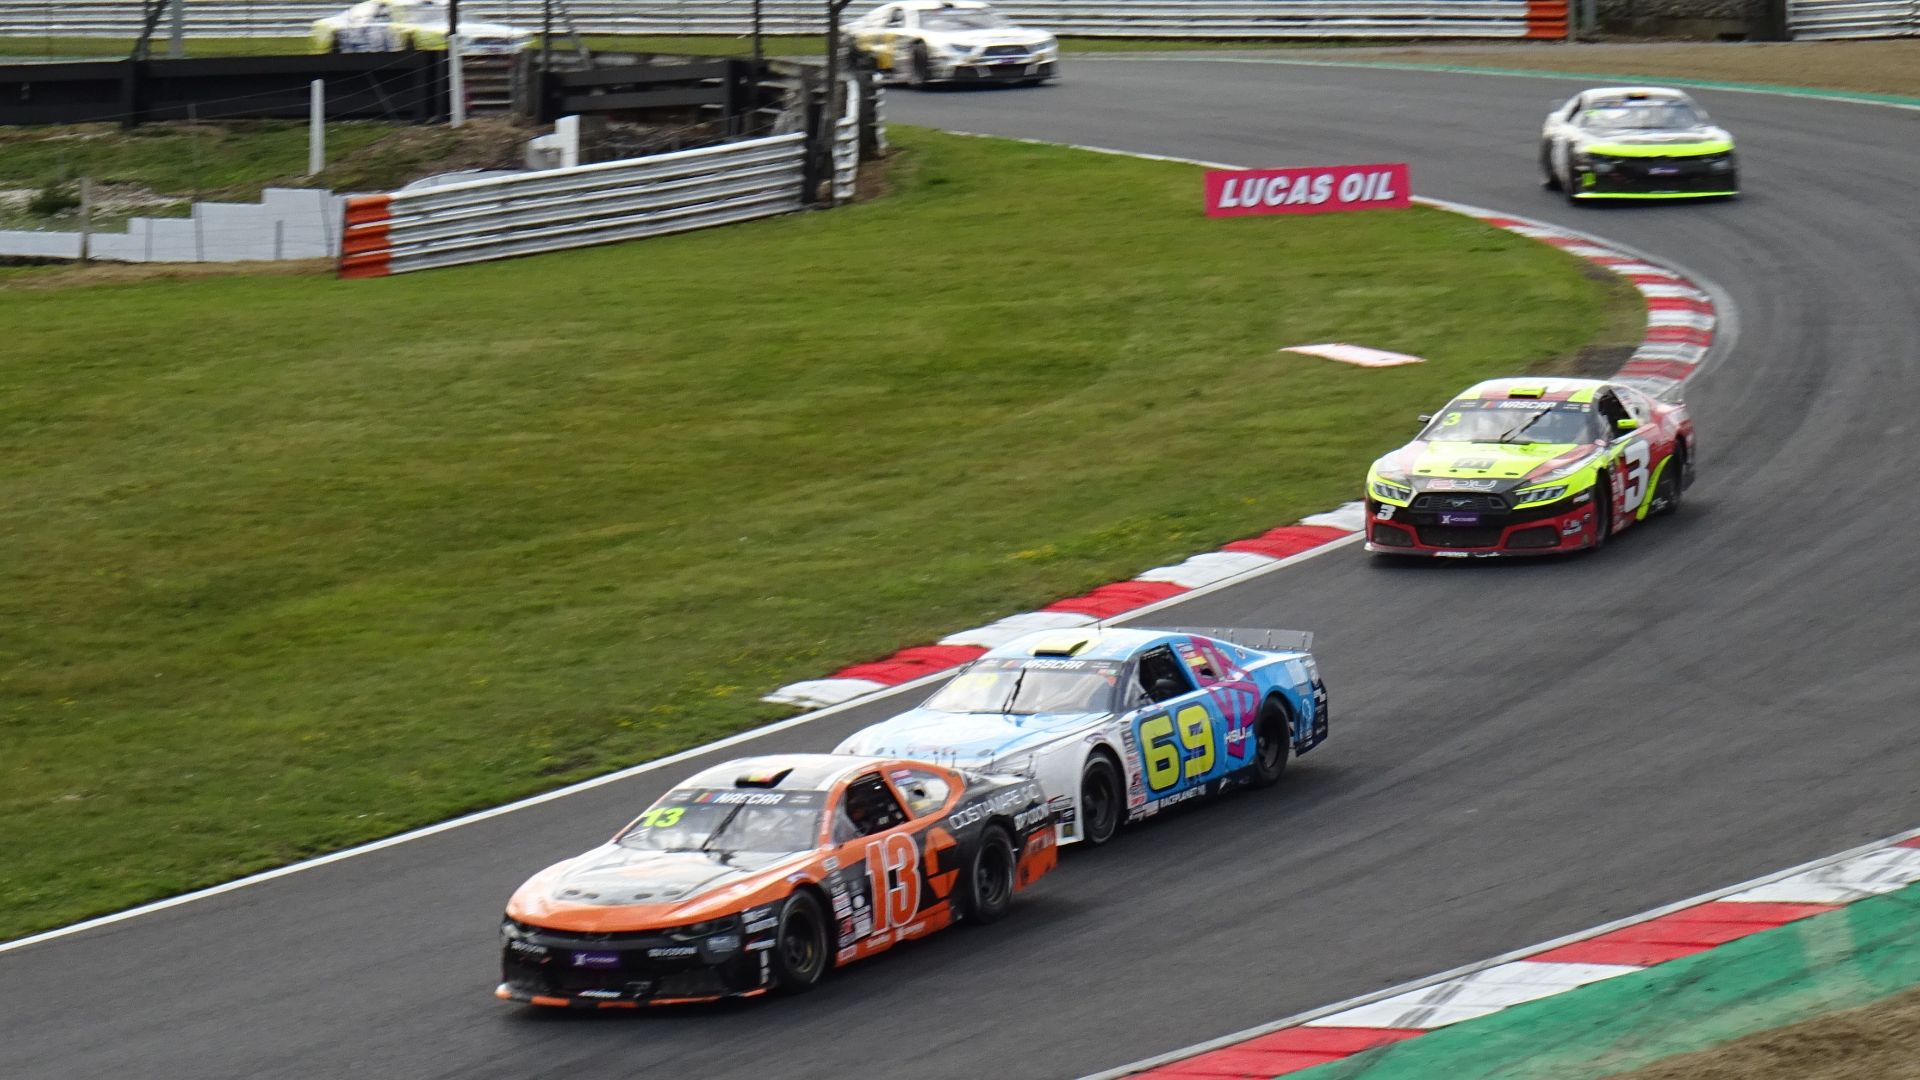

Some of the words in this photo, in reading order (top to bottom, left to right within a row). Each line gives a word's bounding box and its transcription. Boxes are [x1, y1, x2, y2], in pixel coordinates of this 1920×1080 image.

[1218, 174, 1335, 208] LUCAS
[1338, 171, 1395, 203] OIL
[1499, 401, 1557, 409] NASCAR
[1442, 412, 1462, 426] 3
[1623, 440, 1650, 513] 3
[1377, 504, 1396, 520] 3
[1020, 660, 1087, 670] NASCAR
[1139, 703, 1215, 792] 69
[713, 793, 786, 805] NASCAR
[641, 806, 687, 828] 13
[865, 831, 920, 938] 13
